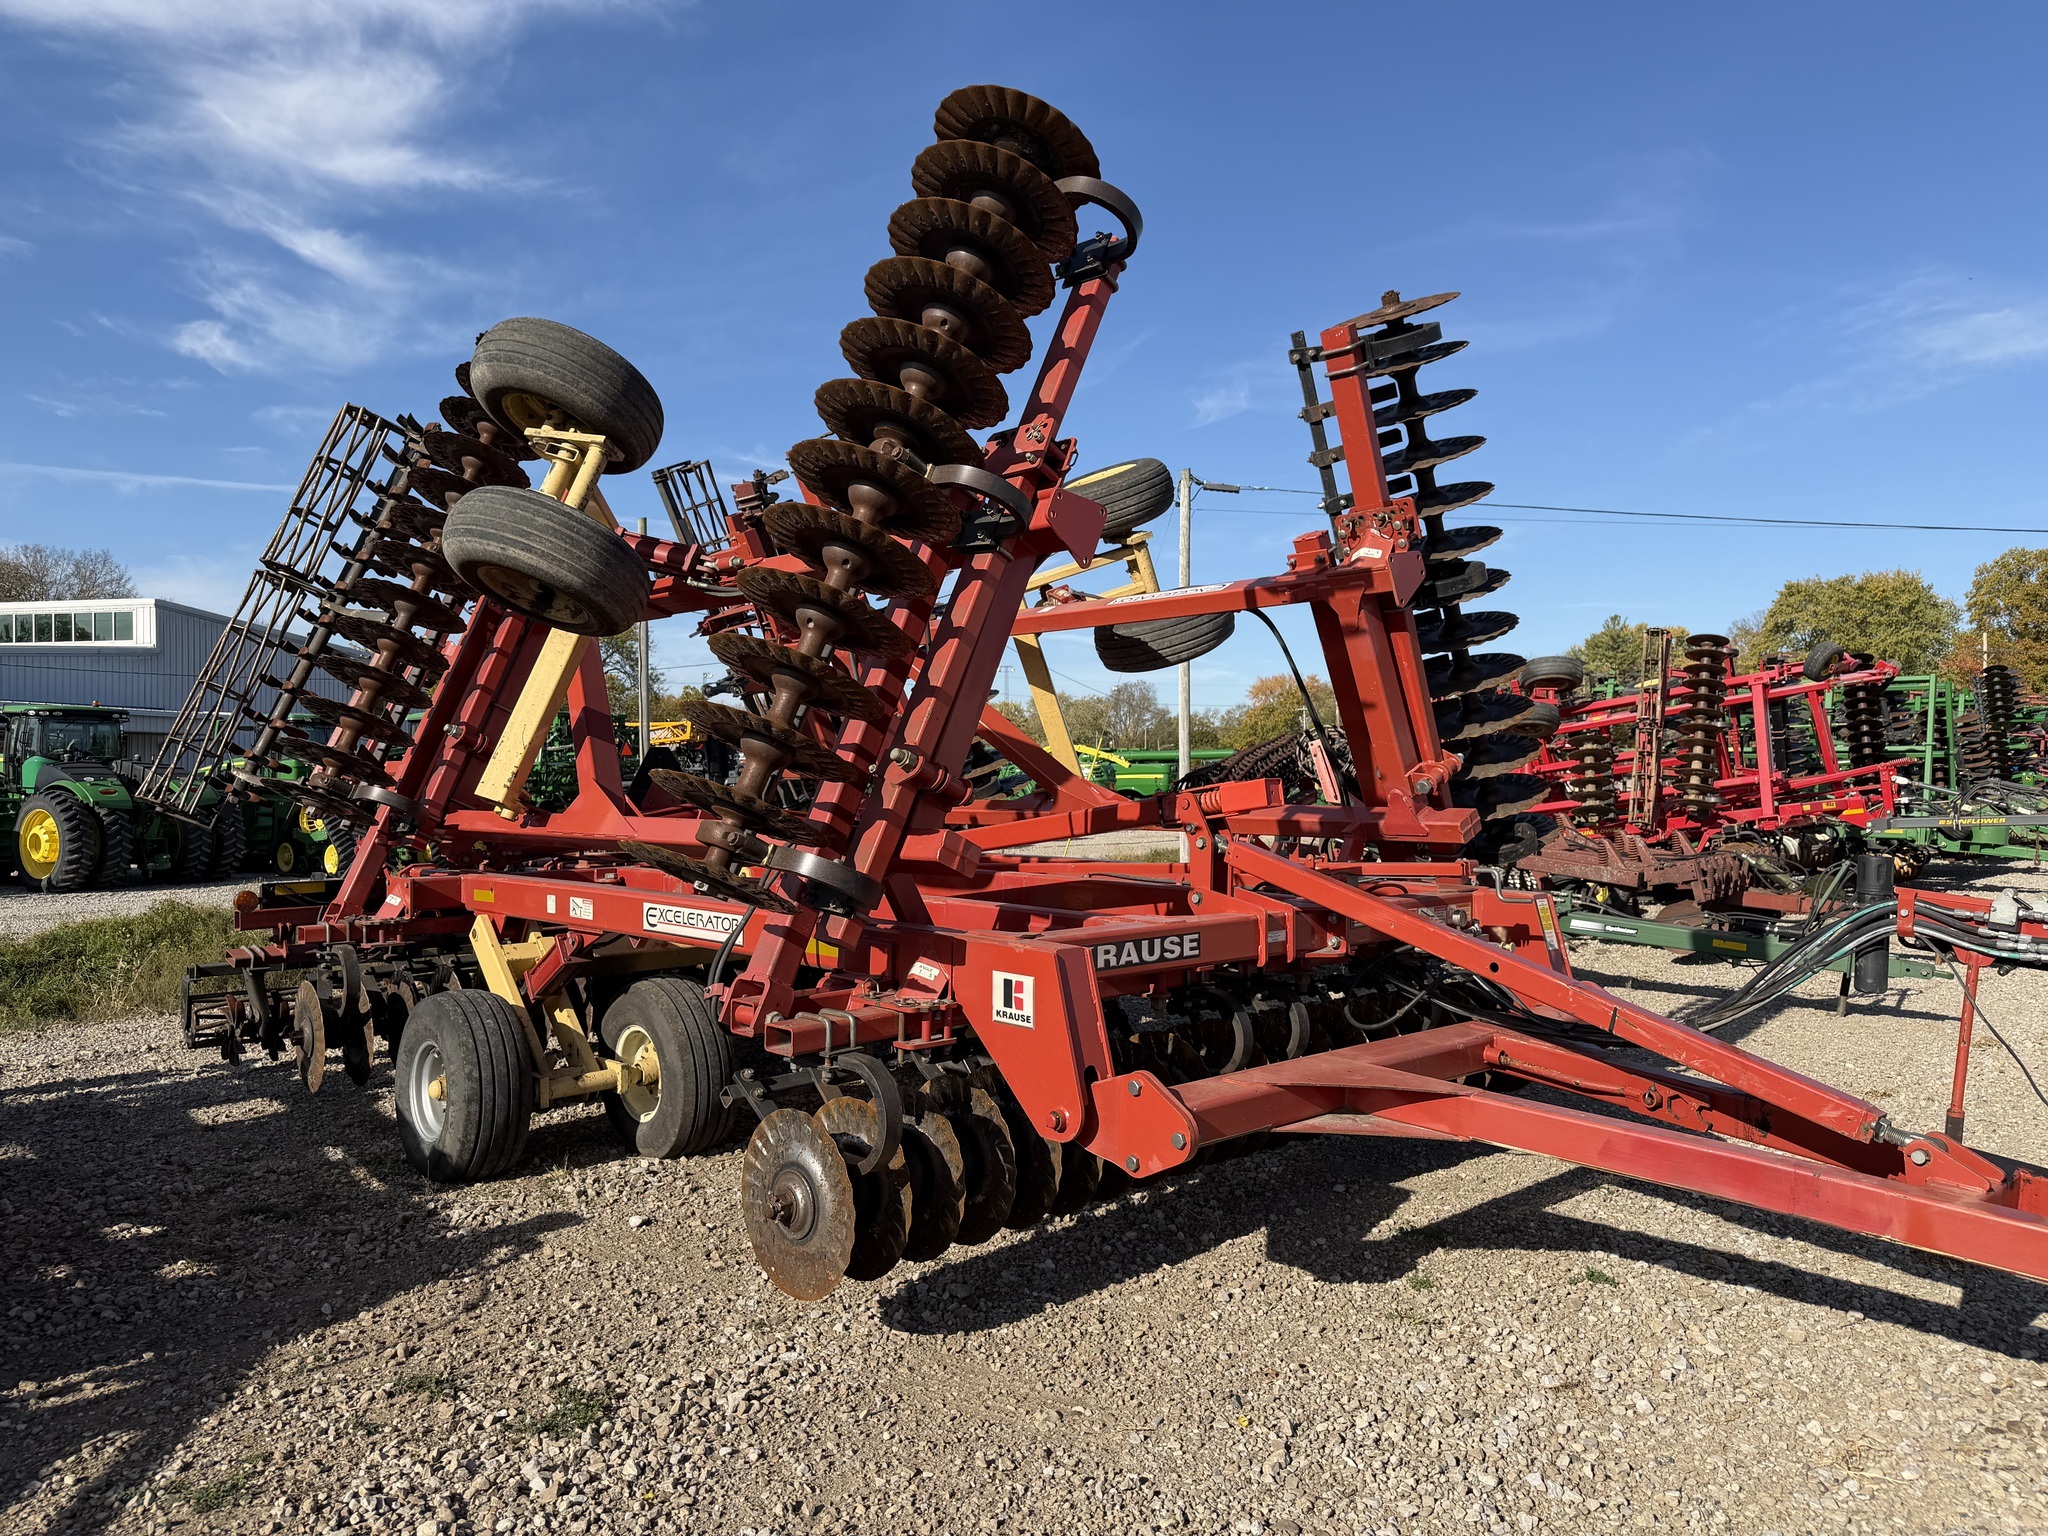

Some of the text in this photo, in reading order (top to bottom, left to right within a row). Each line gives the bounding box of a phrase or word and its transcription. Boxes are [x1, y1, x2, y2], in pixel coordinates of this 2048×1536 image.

[1946, 817, 2006, 825] SNFLOWER
[1091, 933, 1200, 969] RAUSE
[996, 1009, 1032, 1024] KRAUSE
